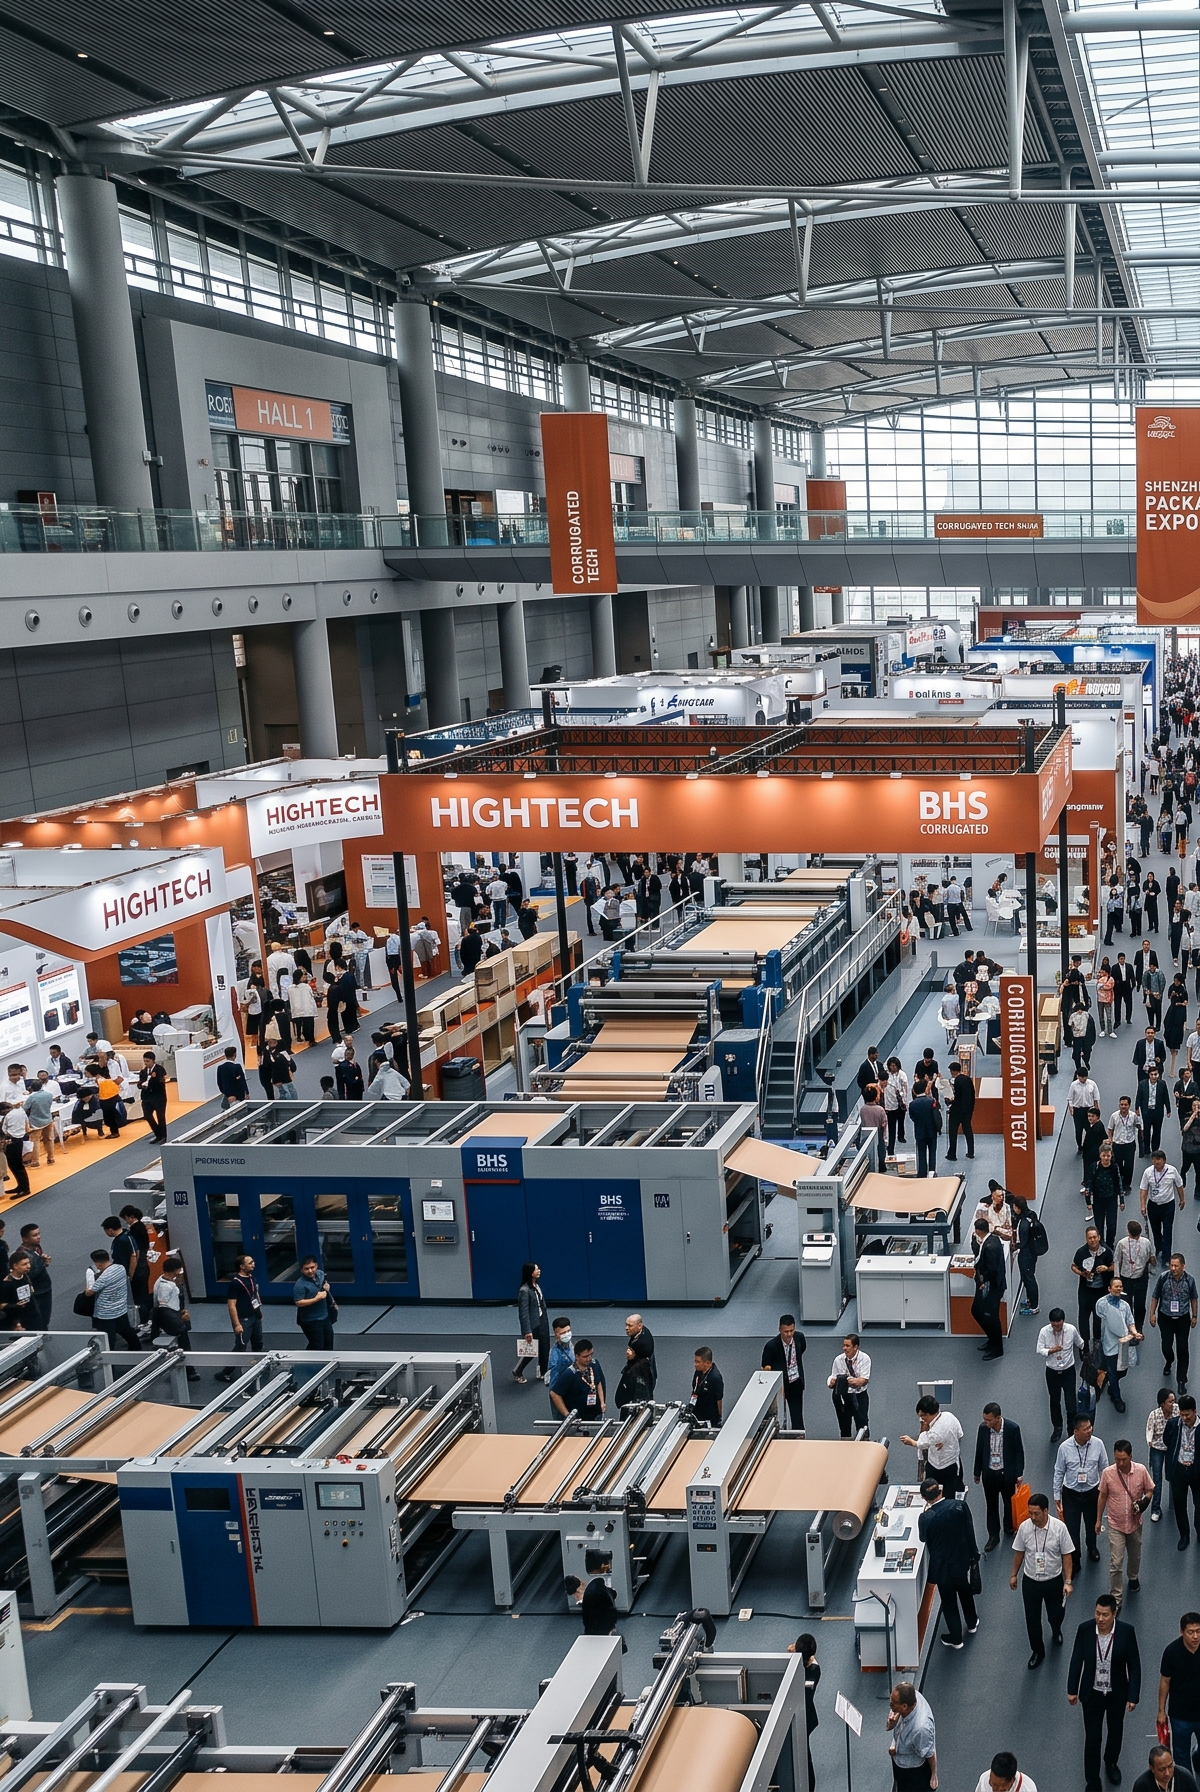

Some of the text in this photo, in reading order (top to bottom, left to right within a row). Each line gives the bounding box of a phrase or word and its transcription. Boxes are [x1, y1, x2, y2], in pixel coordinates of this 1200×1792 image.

[257, 399, 303, 430] HALL
[305, 407, 313, 431] 1
[566, 490, 584, 585] CORRUGATED
[995, 522, 1015, 530] TECH
[1145, 513, 1199, 531] EXPO
[586, 548, 600, 584] TECH
[266, 793, 380, 827] HIGHTECH
[430, 797, 639, 829] HIGHTECH
[919, 790, 989, 821] BHS
[920, 823, 989, 835] CORRUGATED
[103, 868, 212, 931] HIGHTECH
[476, 1153, 508, 1168] BHS
[600, 1194, 623, 1205] BHS
